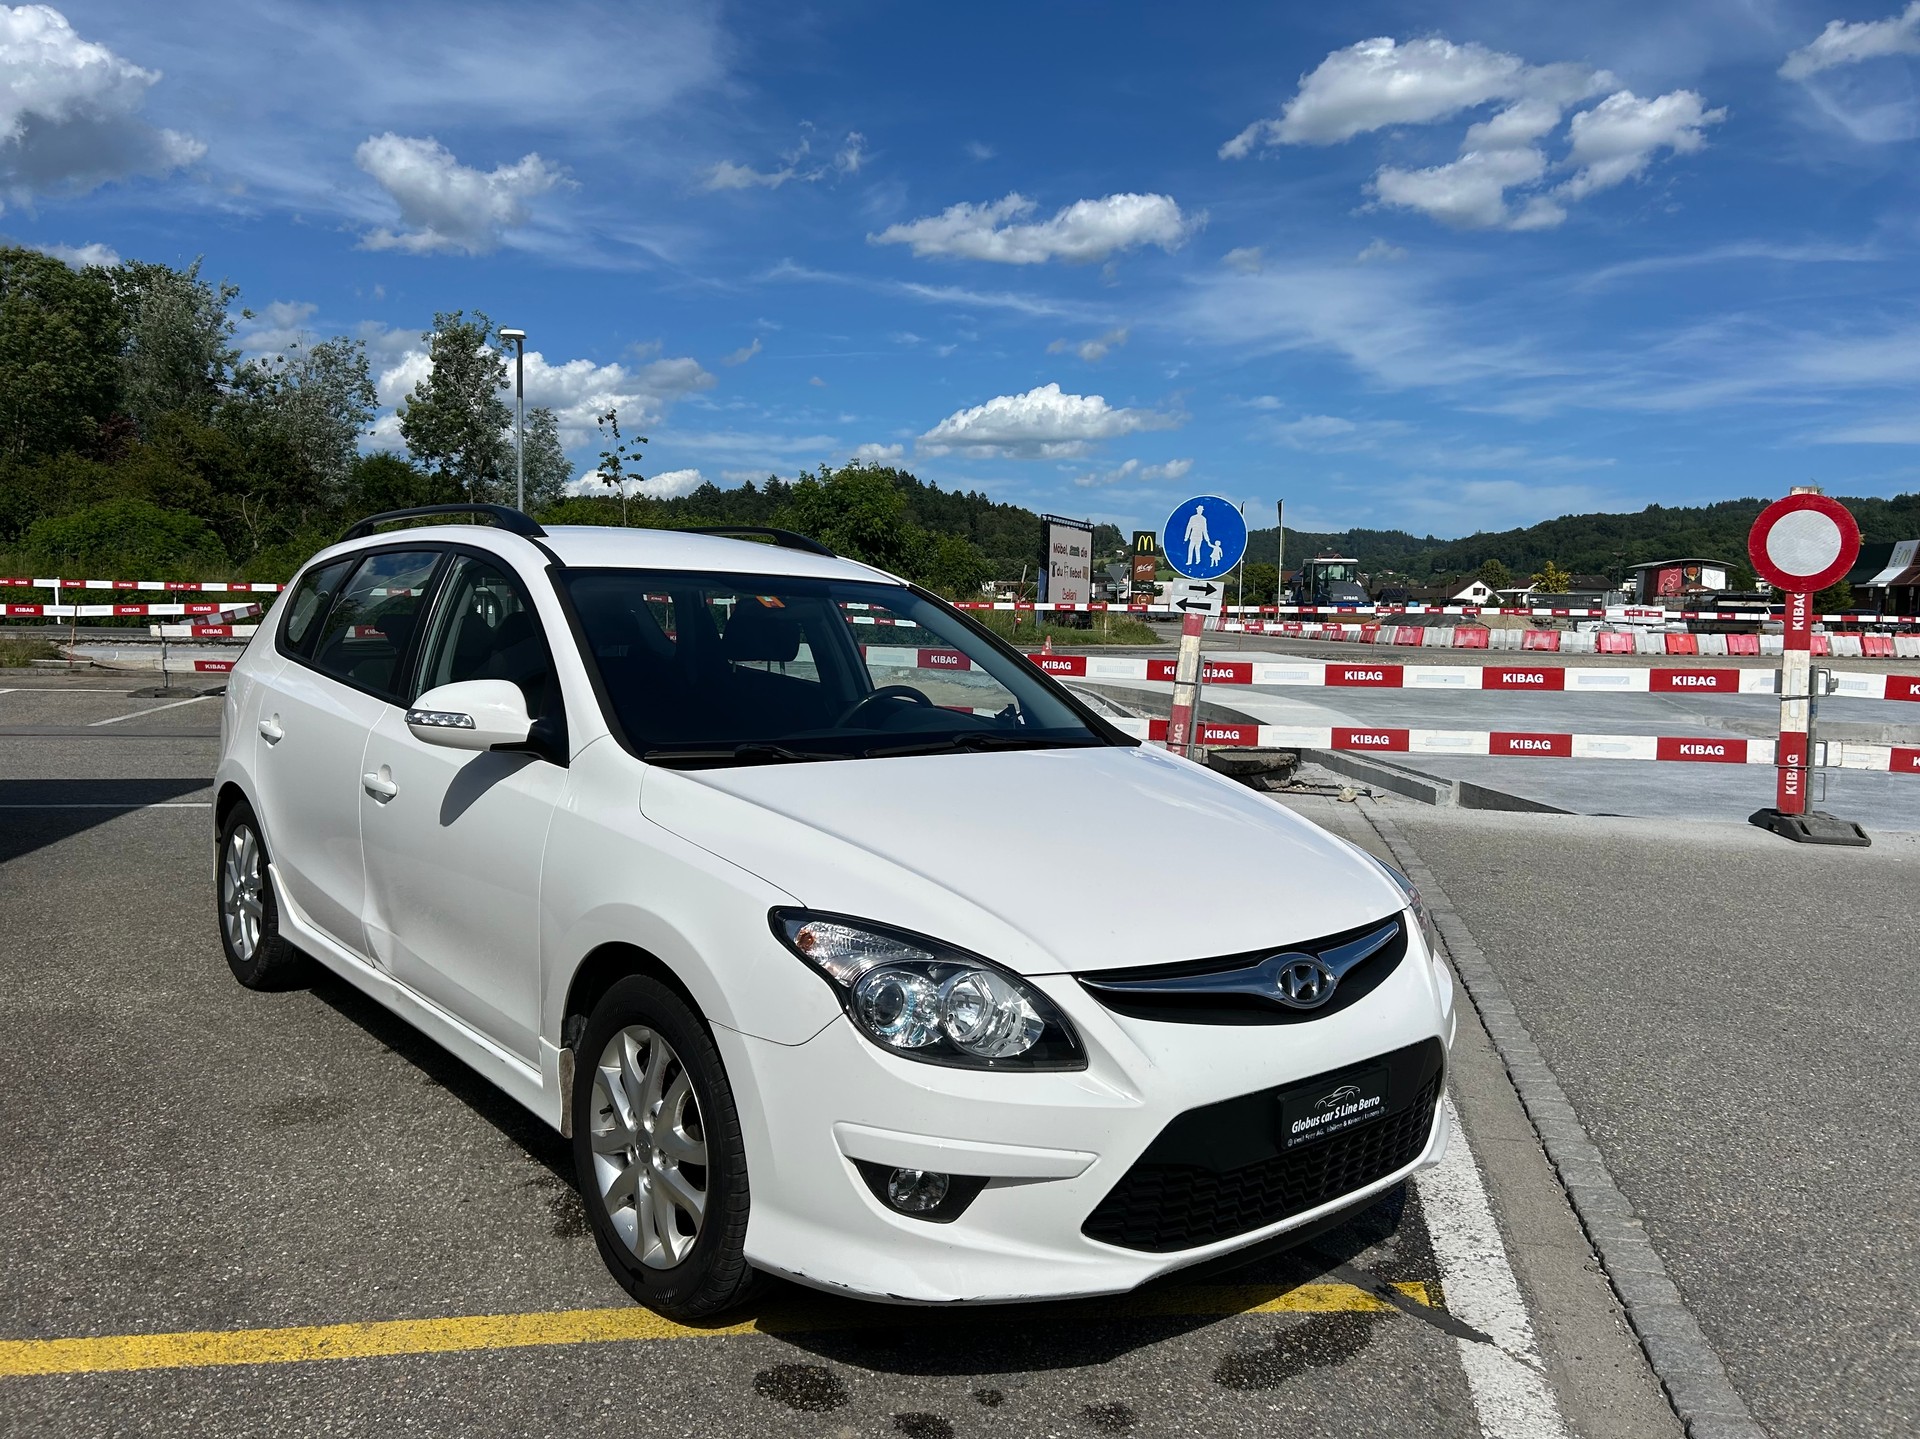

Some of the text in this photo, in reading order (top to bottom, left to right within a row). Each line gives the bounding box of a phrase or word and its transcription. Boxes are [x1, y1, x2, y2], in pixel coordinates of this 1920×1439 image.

[931, 655, 957, 664] KIBAG
[1042, 661, 1071, 670] KIBAG
[1344, 671, 1383, 680] KIBAG
[1502, 673, 1544, 683] KIBAG
[1672, 676, 1717, 686] KIBAG
[1205, 730, 1239, 739] KIBAG
[1350, 735, 1390, 744] KIBAG
[1509, 739, 1551, 750] KIBAG
[1680, 744, 1725, 755] KIBAG
[1785, 754, 1798, 795] KIBAG
[1291, 1095, 1380, 1134] Globus car S Line Berro
